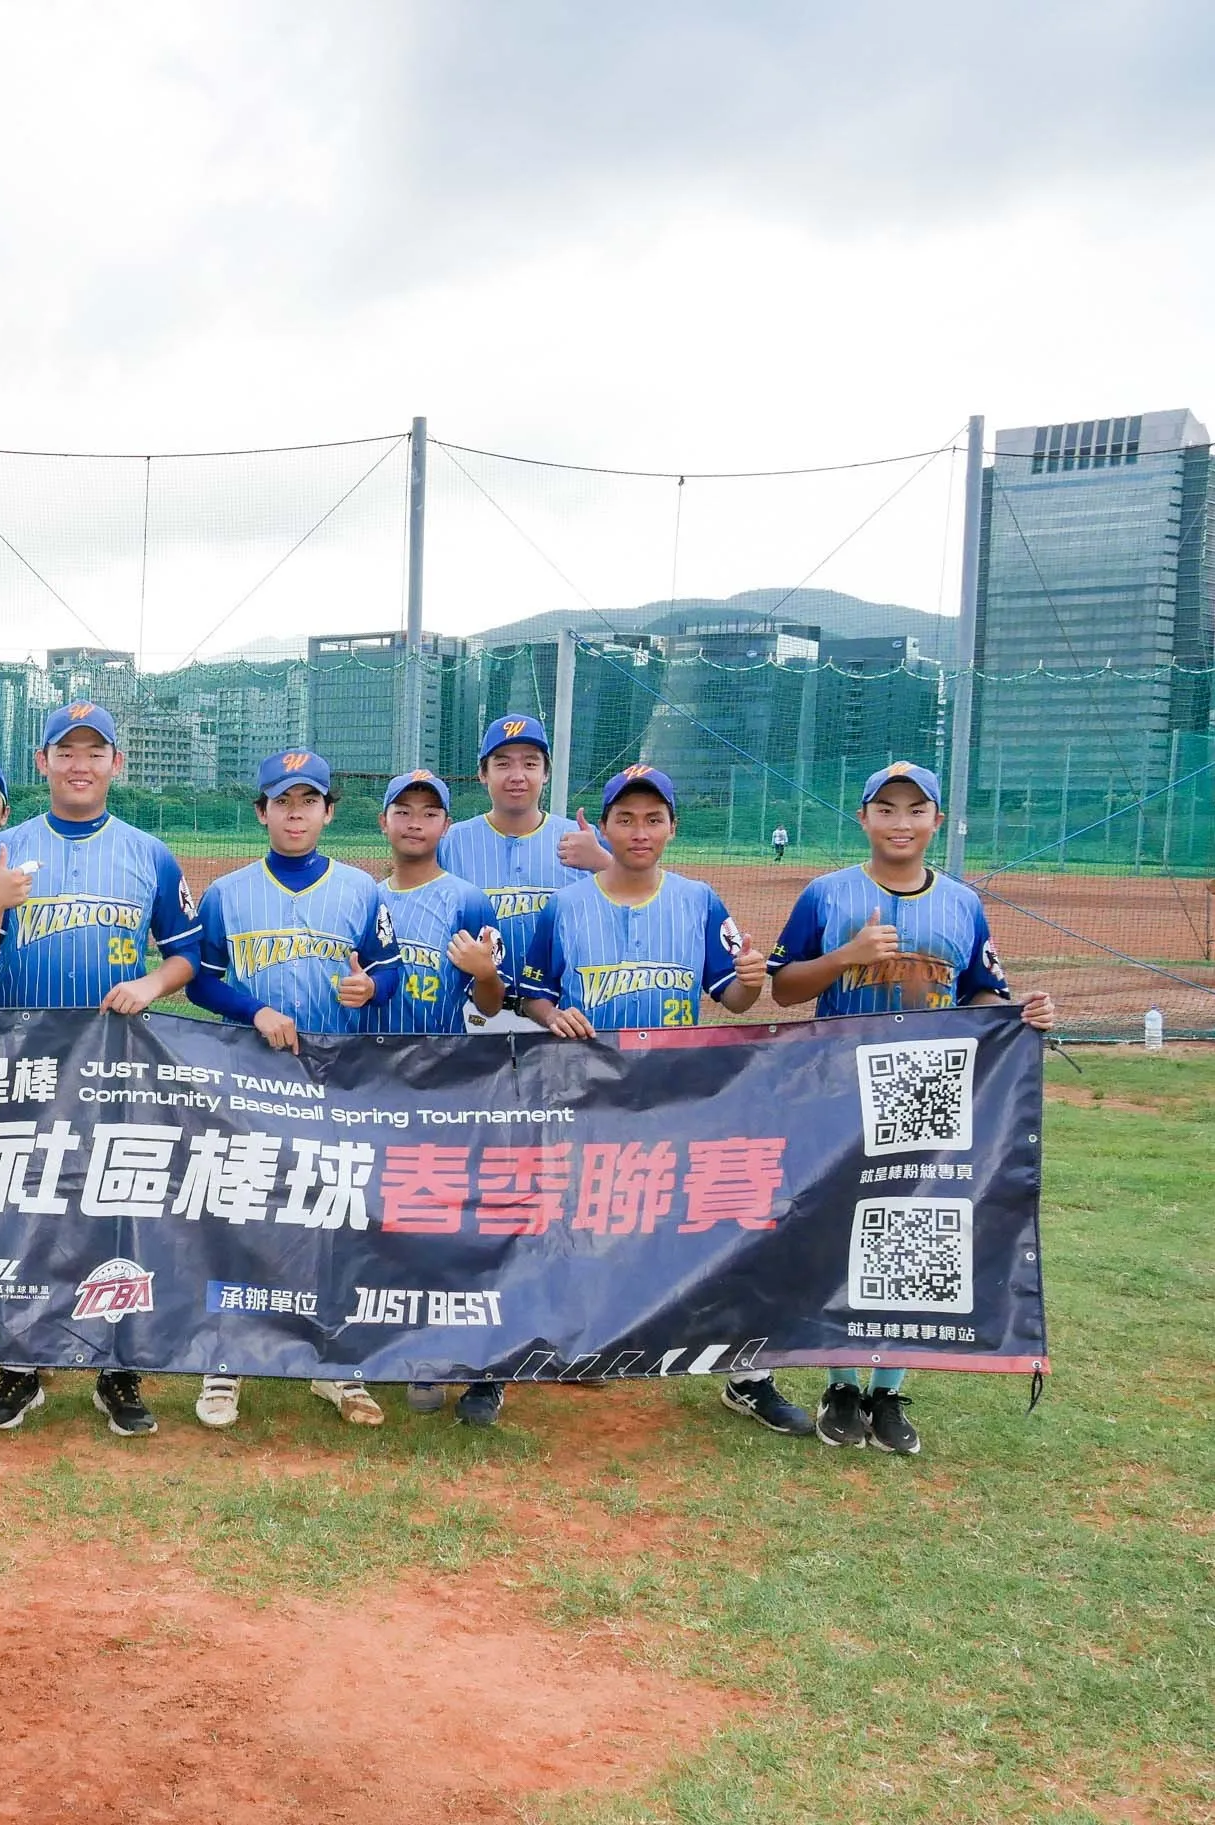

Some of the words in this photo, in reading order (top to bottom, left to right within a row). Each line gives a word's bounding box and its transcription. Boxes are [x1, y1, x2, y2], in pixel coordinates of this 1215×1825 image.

[69, 704, 95, 720] W
[503, 721, 526, 738] W
[283, 754, 310, 772] W
[16, 893, 144, 950] WARRIORS
[108, 937, 137, 965] 35
[406, 974, 440, 1003] 42
[575, 960, 695, 1011] WARRIORS
[663, 998, 694, 1026] 23
[79, 1061, 150, 1080] JUST
[156, 1065, 224, 1086] BEST
[230, 1073, 326, 1100] TAIWAN
[78, 1087, 222, 1113] Community
[229, 1096, 324, 1121] Baseball
[330, 1107, 409, 1128] Spring
[416, 1106, 575, 1125] Tournament
[859, 1163, 974, 1184] 就是棒粉絲專頁
[219, 1285, 319, 1317] 承辦單位
[344, 1286, 424, 1324] JUST
[426, 1290, 502, 1327] BEST
[847, 1321, 976, 1343] 就是棒賽事網站
